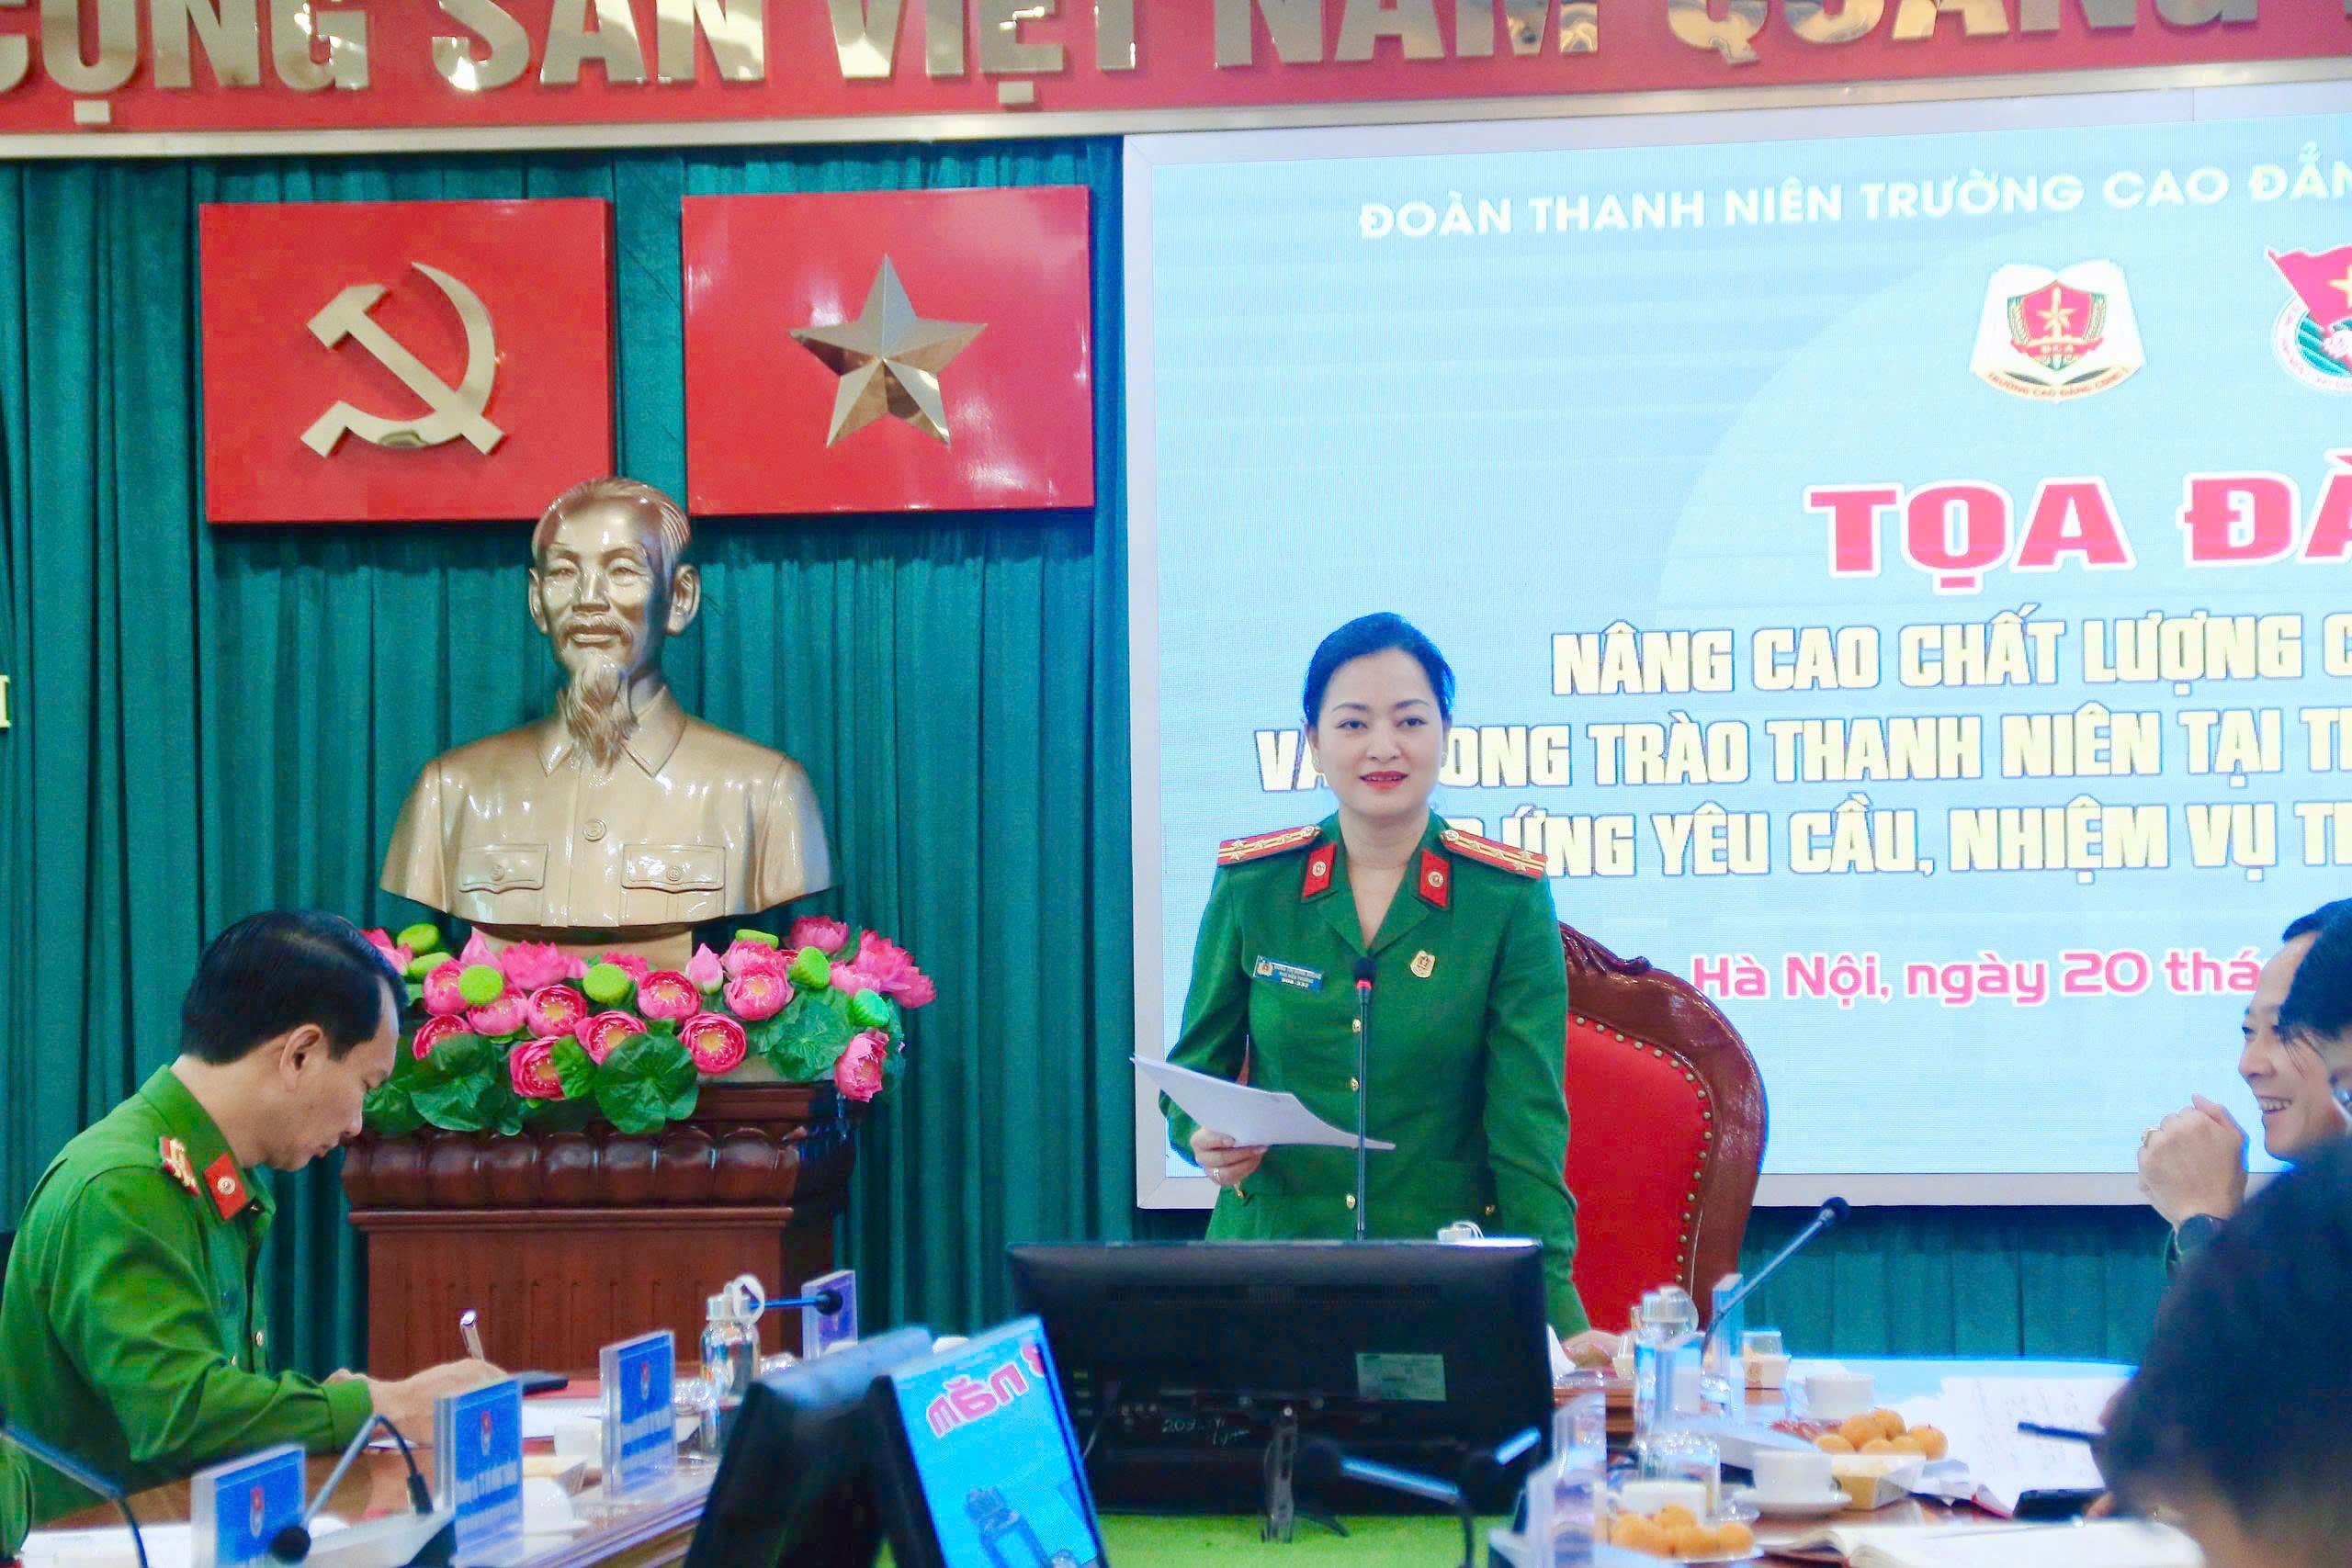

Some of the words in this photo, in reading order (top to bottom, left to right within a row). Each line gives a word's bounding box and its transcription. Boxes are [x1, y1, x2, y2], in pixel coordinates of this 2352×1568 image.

[1359, 189, 1511, 239] ĐOÀN
[1529, 190, 1705, 232] THANH
[1724, 175, 1842, 227] NIÊN
[1860, 169, 2086, 220] TRƯỜNG
[2102, 166, 2231, 209] CAO
[1810, 482, 2131, 590] TỌA
[1551, 620, 1736, 696] NÂNG
[1751, 626, 1881, 690] CAO
[1898, 603, 2066, 688] CHẤT
[2082, 609, 2304, 696] LƯỢNG
[1439, 725, 1572, 788] ONG
[1586, 709, 1749, 786] TRÀO
[1766, 714, 1984, 784] THANH
[2000, 701, 2162, 778] NIÊN
[2177, 708, 2282, 788] TẠI
[1651, 800, 1772, 876] YÊU
[1789, 792, 1934, 878] CẦU,
[1948, 794, 2169, 886] NHIỆM
[2185, 802, 2278, 883] VỤ
[1693, 955, 1767, 997] Hà
[1785, 954, 1890, 1007] Nội,
[1907, 952, 2045, 1005] ngày
[2064, 951, 2148, 993] 20
[2164, 949, 2262, 992] thá
